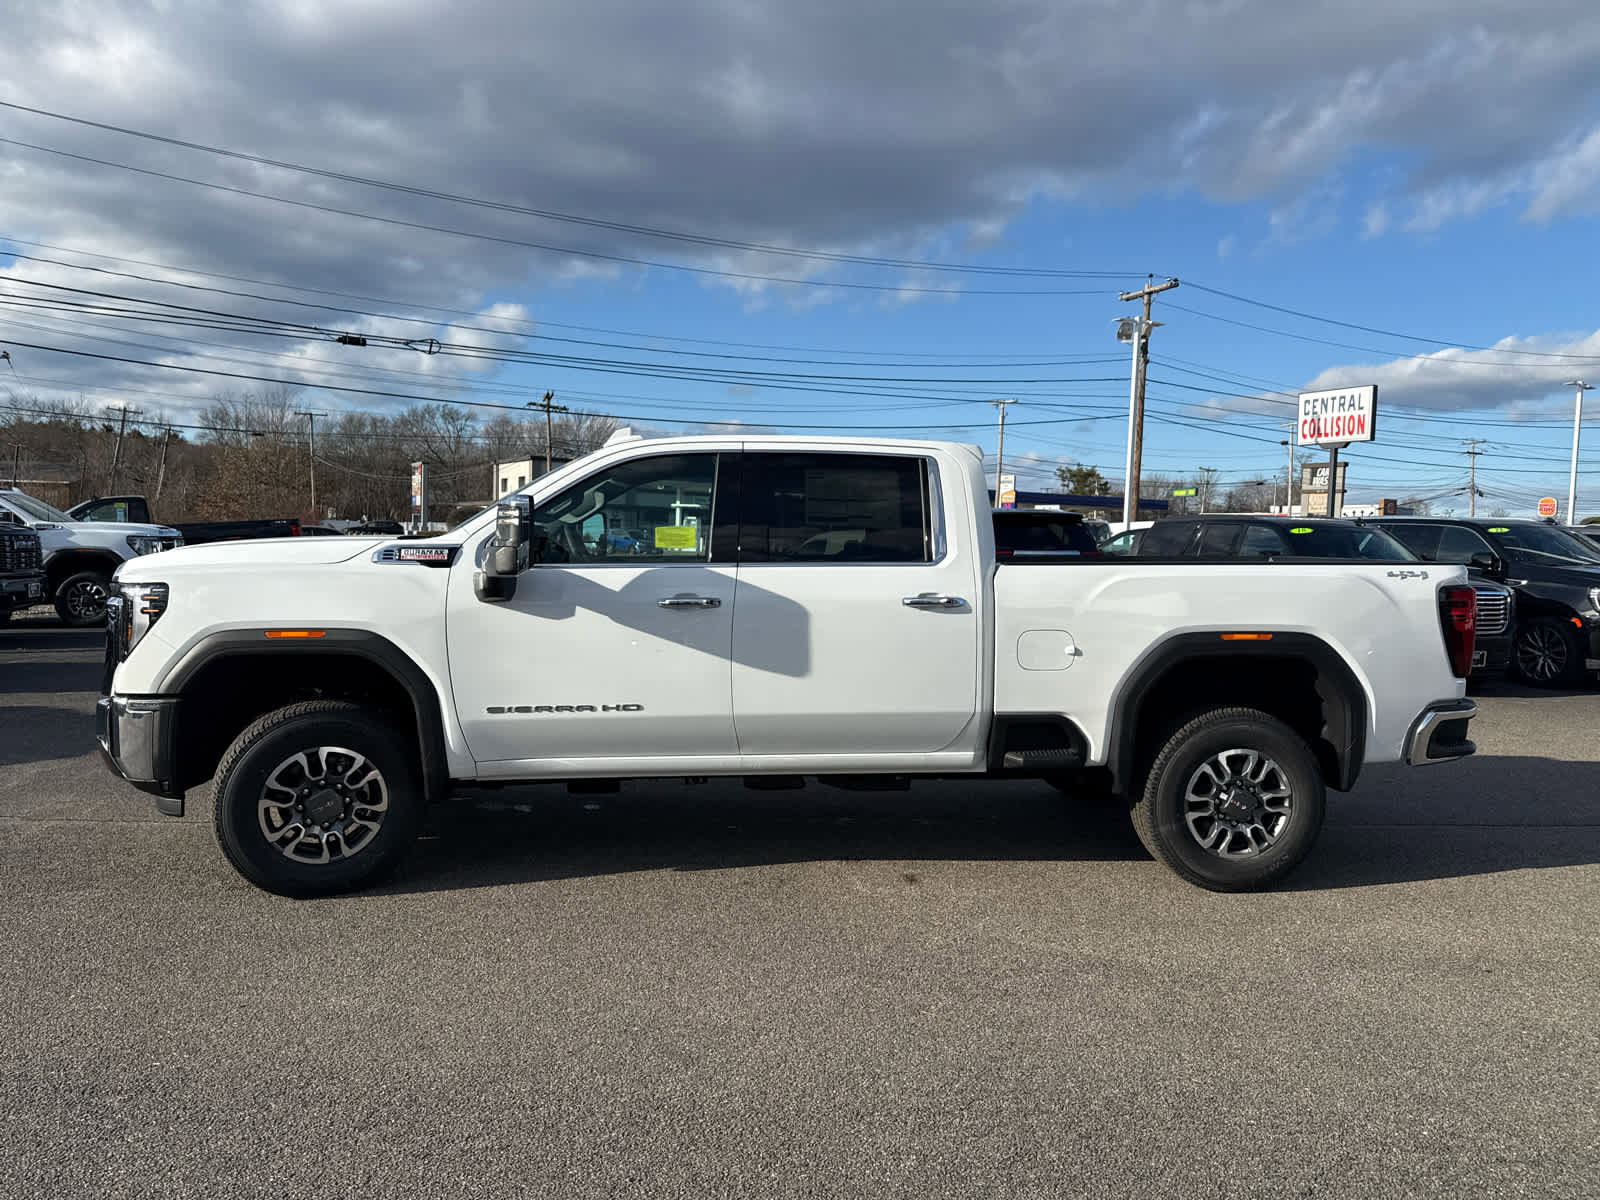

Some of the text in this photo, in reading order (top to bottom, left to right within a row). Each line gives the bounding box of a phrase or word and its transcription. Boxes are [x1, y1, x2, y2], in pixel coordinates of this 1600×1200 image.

[1303, 392, 1365, 416] CENTRAL
[1301, 414, 1366, 439] COLLISION
[486, 703, 644, 714] SIERRA HD
